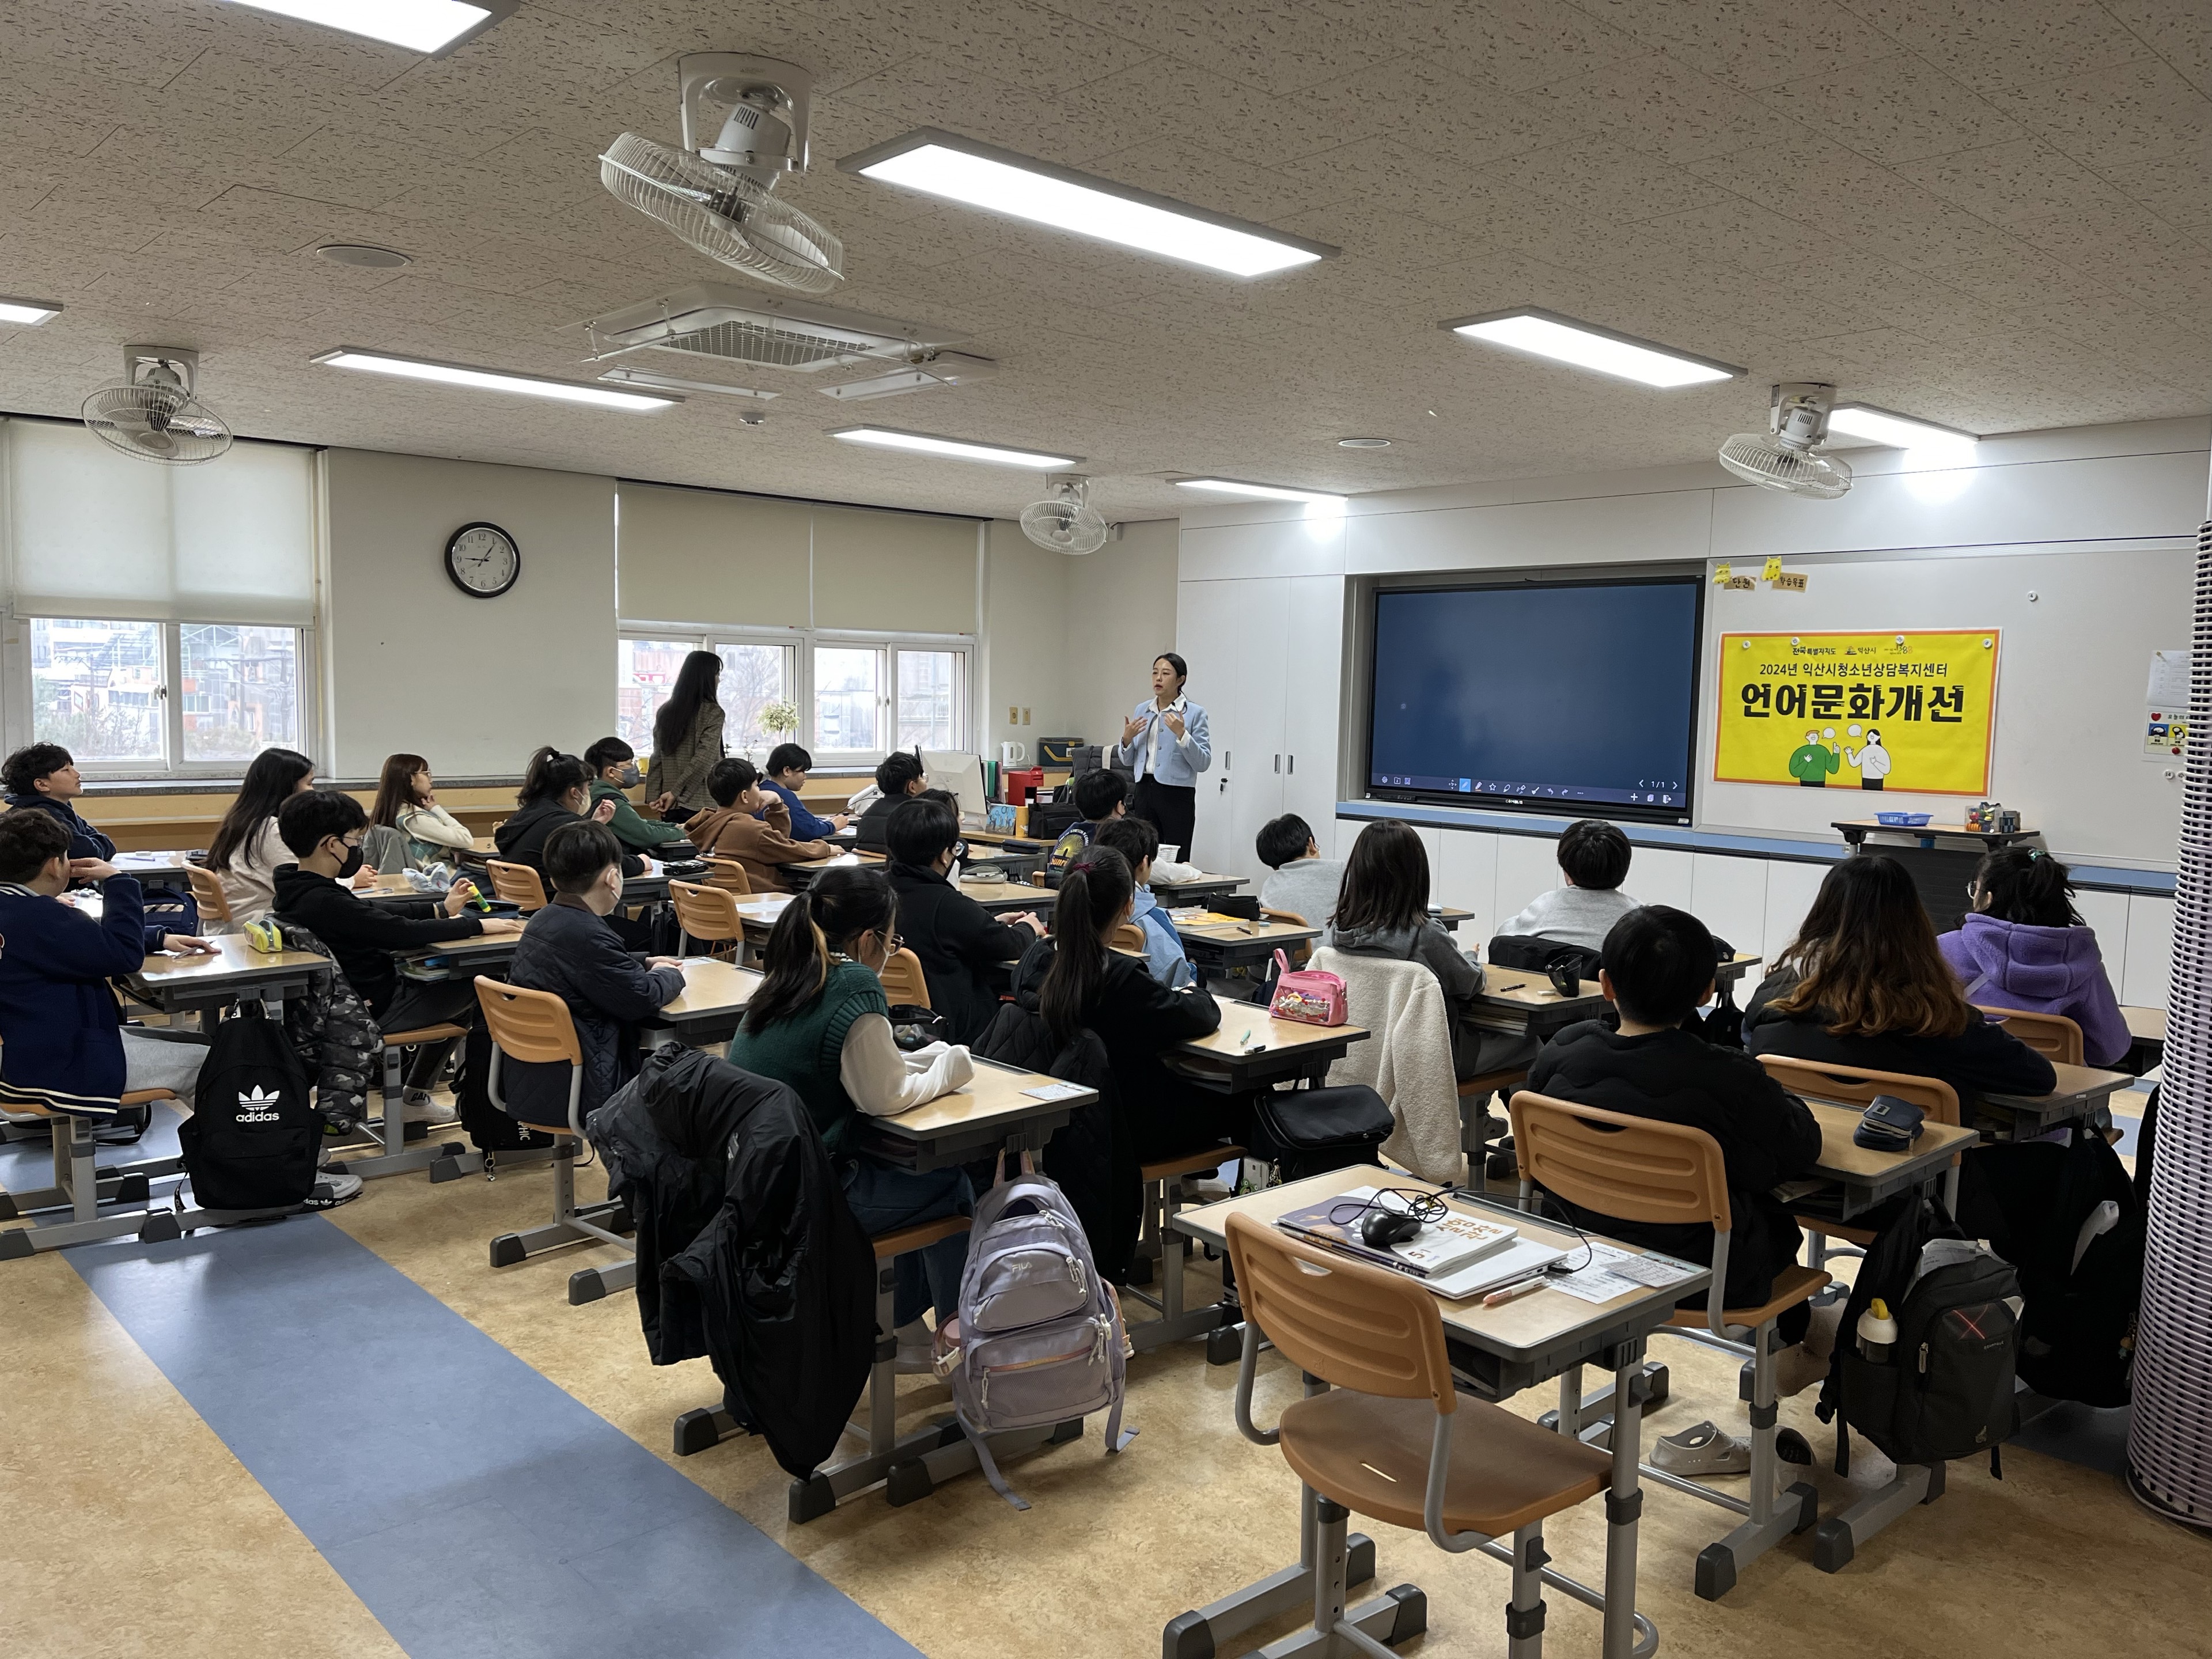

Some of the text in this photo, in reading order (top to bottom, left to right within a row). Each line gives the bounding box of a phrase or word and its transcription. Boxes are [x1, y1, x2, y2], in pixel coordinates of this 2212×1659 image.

[1732, 578, 1749, 588] 단원
[1780, 577, 1804, 588] 학습목표
[1760, 662, 1947, 677] 2024년 익산시청소년상담복지센터
[1741, 683, 1964, 722] 언어문화개선
[236, 1112, 279, 1122] adidas
